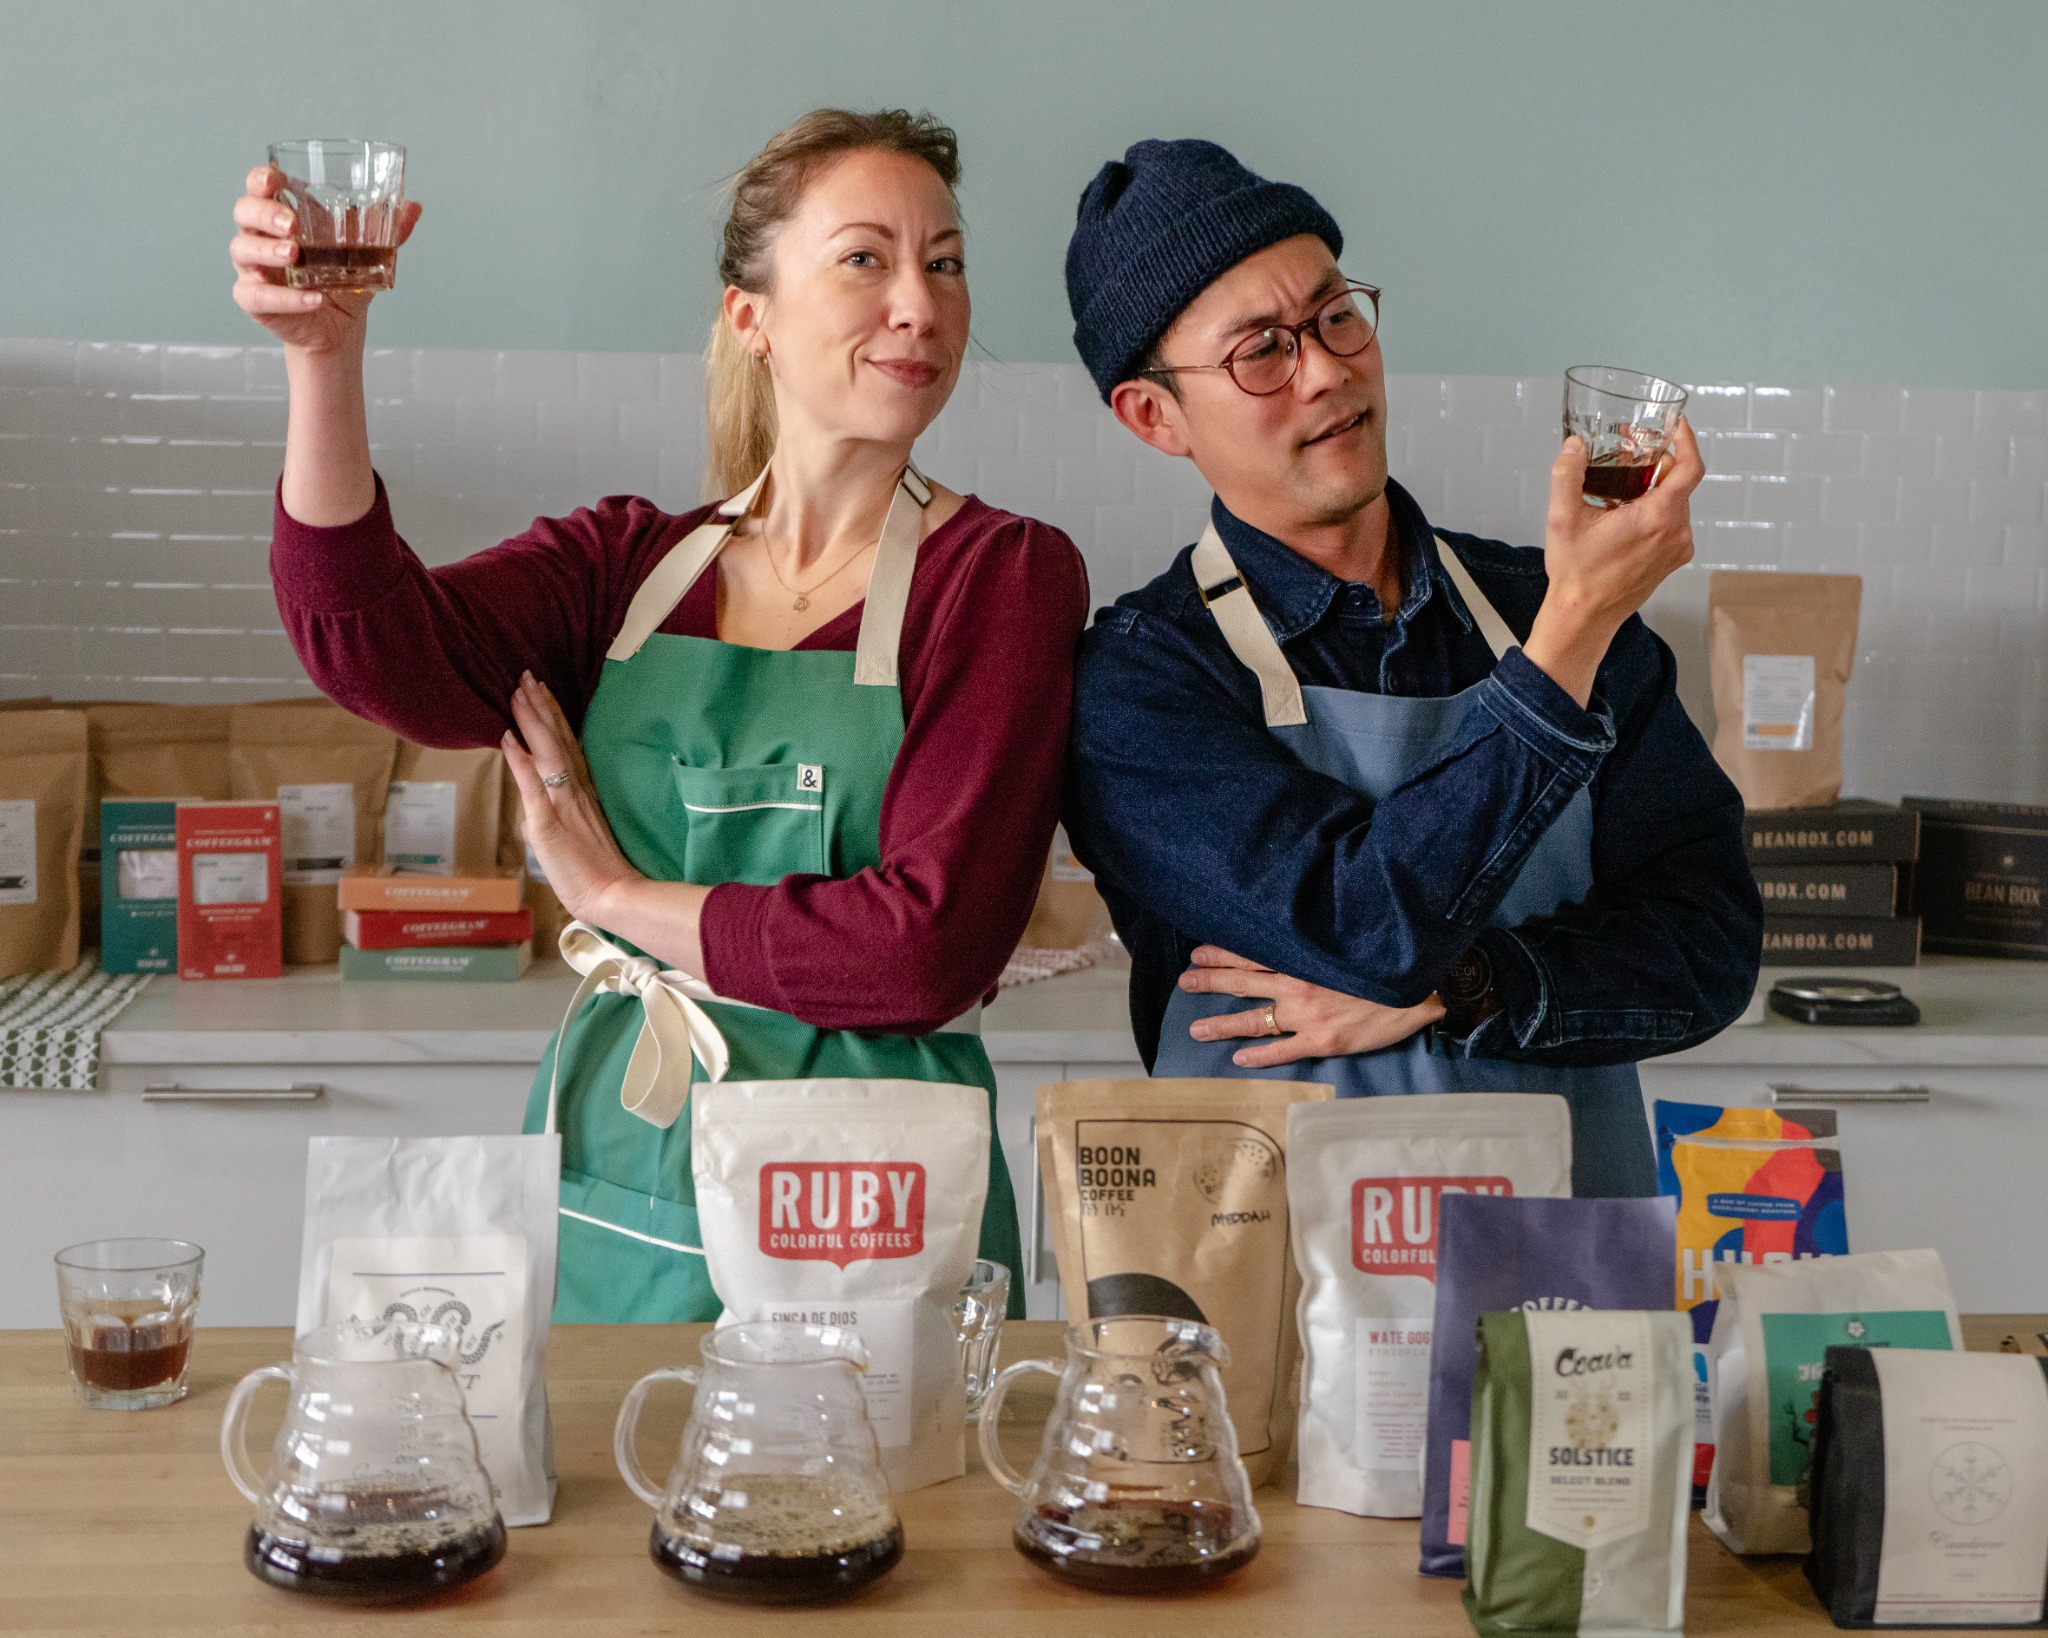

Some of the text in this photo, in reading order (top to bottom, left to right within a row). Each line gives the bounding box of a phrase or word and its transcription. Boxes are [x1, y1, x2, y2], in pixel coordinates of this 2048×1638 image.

[803, 769, 817, 788] &
[1752, 831, 1874, 848] BEANBOX.COM
[2008, 885, 2041, 906] BOX
[1080, 1147, 1140, 1165] BOON
[1080, 1168, 1156, 1188] BOONA
[771, 1171, 916, 1229] RUBY
[1080, 1189, 1135, 1201] COFFEE
[770, 1232, 911, 1249] COLORFUL COFFEES
[1362, 1249, 1437, 1265] COLORFUL
[772, 1311, 857, 1325] FINCA DE DIOS
[1369, 1331, 1432, 1344] WATE GOG
[1549, 1447, 1634, 1466] SOLSTICE
[1551, 1475, 1631, 1486] SELECT BLEND
